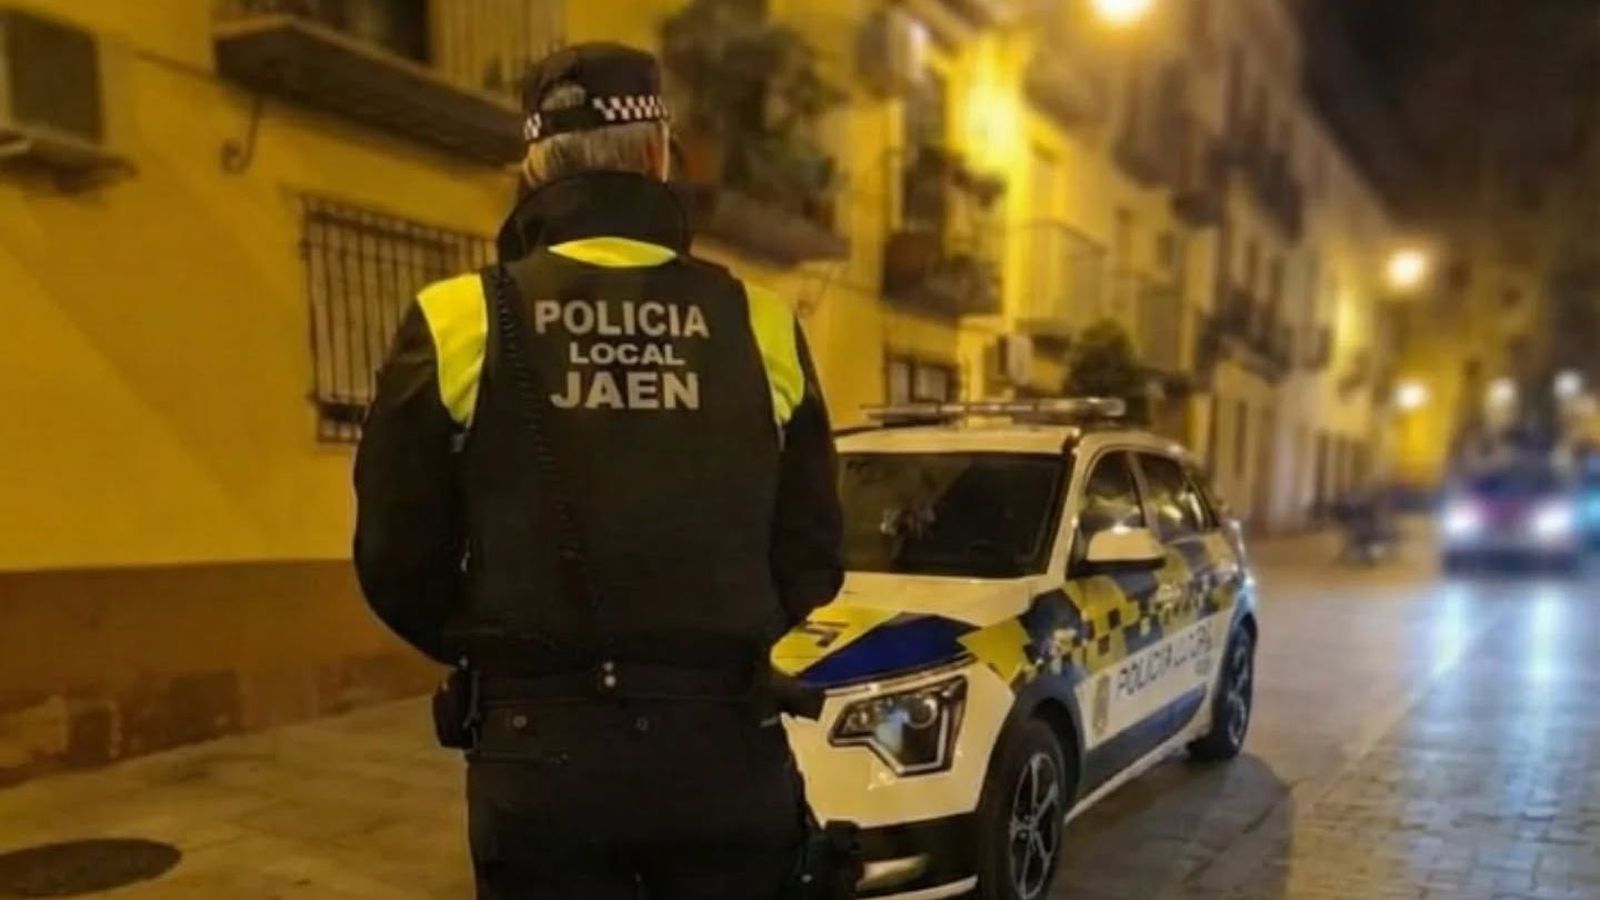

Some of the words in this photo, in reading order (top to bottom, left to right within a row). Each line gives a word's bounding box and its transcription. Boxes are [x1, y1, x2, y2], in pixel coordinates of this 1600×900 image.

[535, 300, 710, 338] POLICIA
[570, 342, 685, 365] LOCAL
[550, 371, 700, 410] JAEN
